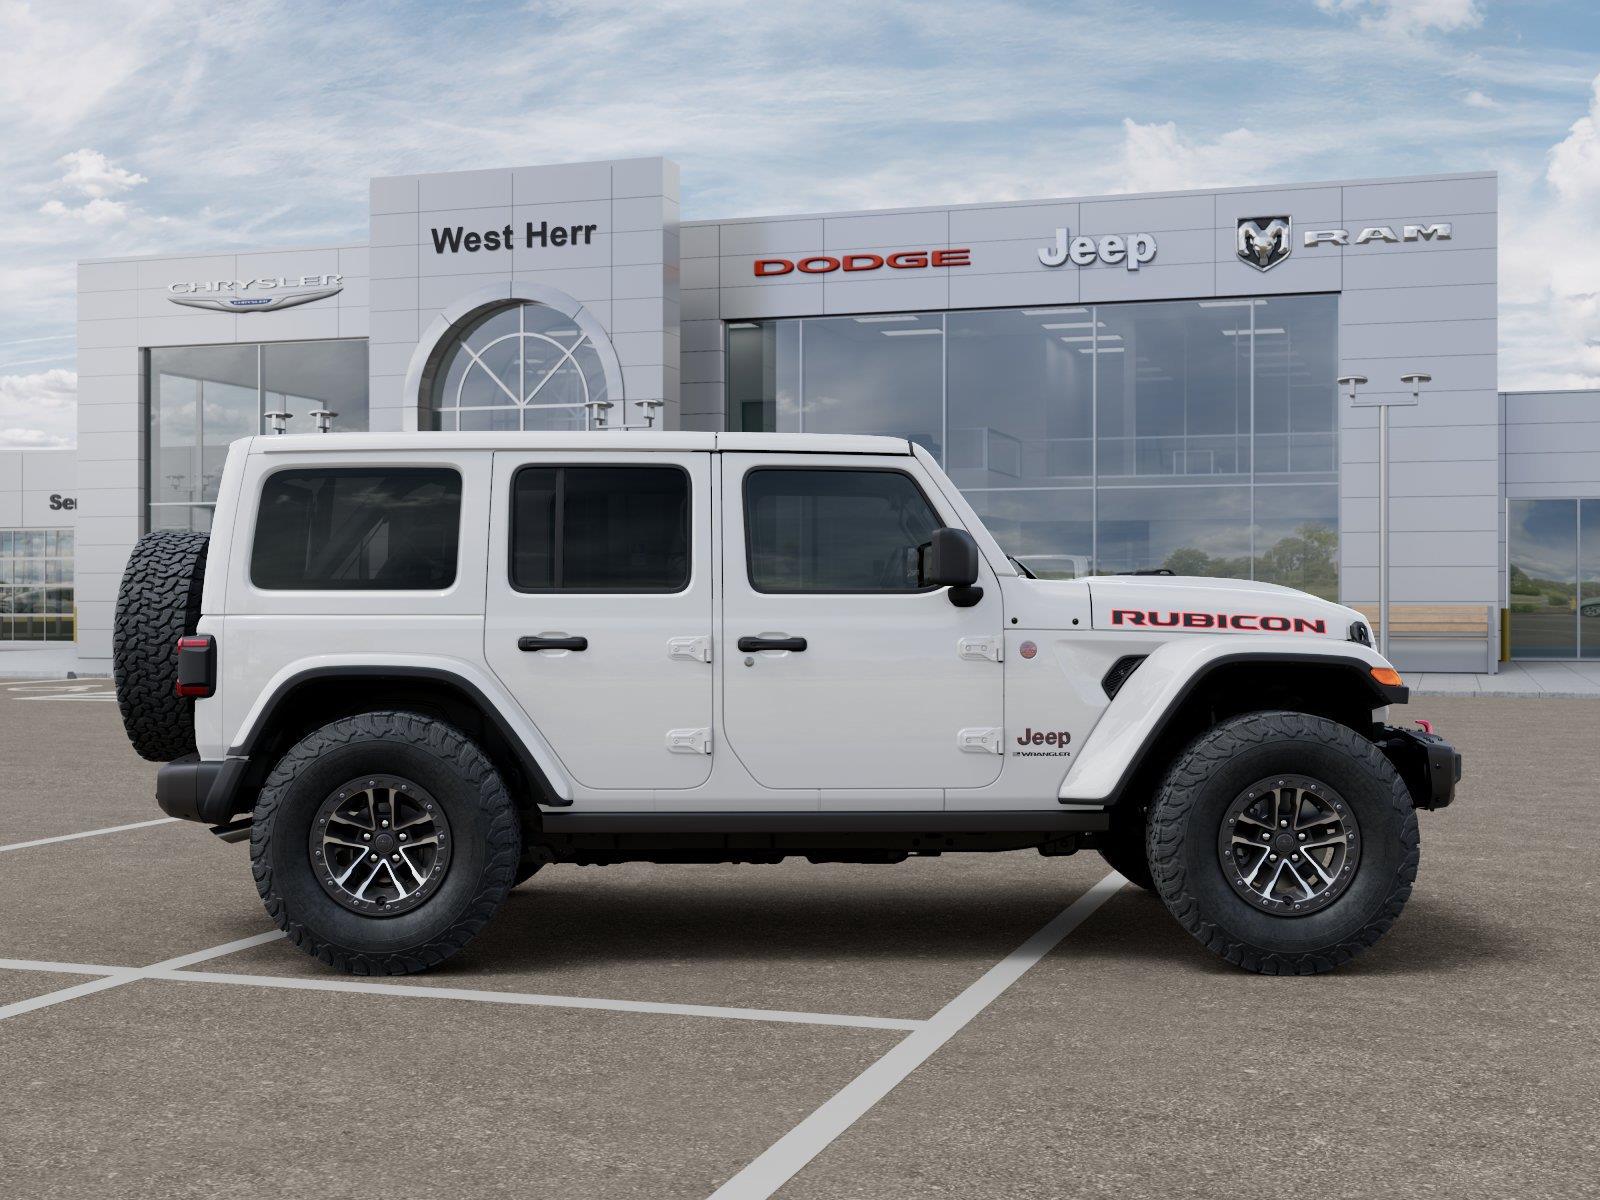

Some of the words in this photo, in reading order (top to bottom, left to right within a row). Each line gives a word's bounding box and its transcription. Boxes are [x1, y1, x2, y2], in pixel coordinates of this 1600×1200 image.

[431, 224, 514, 254] West
[526, 221, 597, 249] Herr
[1304, 223, 1452, 248] RAM
[1037, 227, 1157, 271] Jeep
[754, 249, 971, 276] DODGE
[168, 273, 344, 294] CHRYSLER
[49, 494, 77, 511] Se
[1111, 609, 1326, 634] RUBICON
[1016, 728, 1071, 748] Jeep
